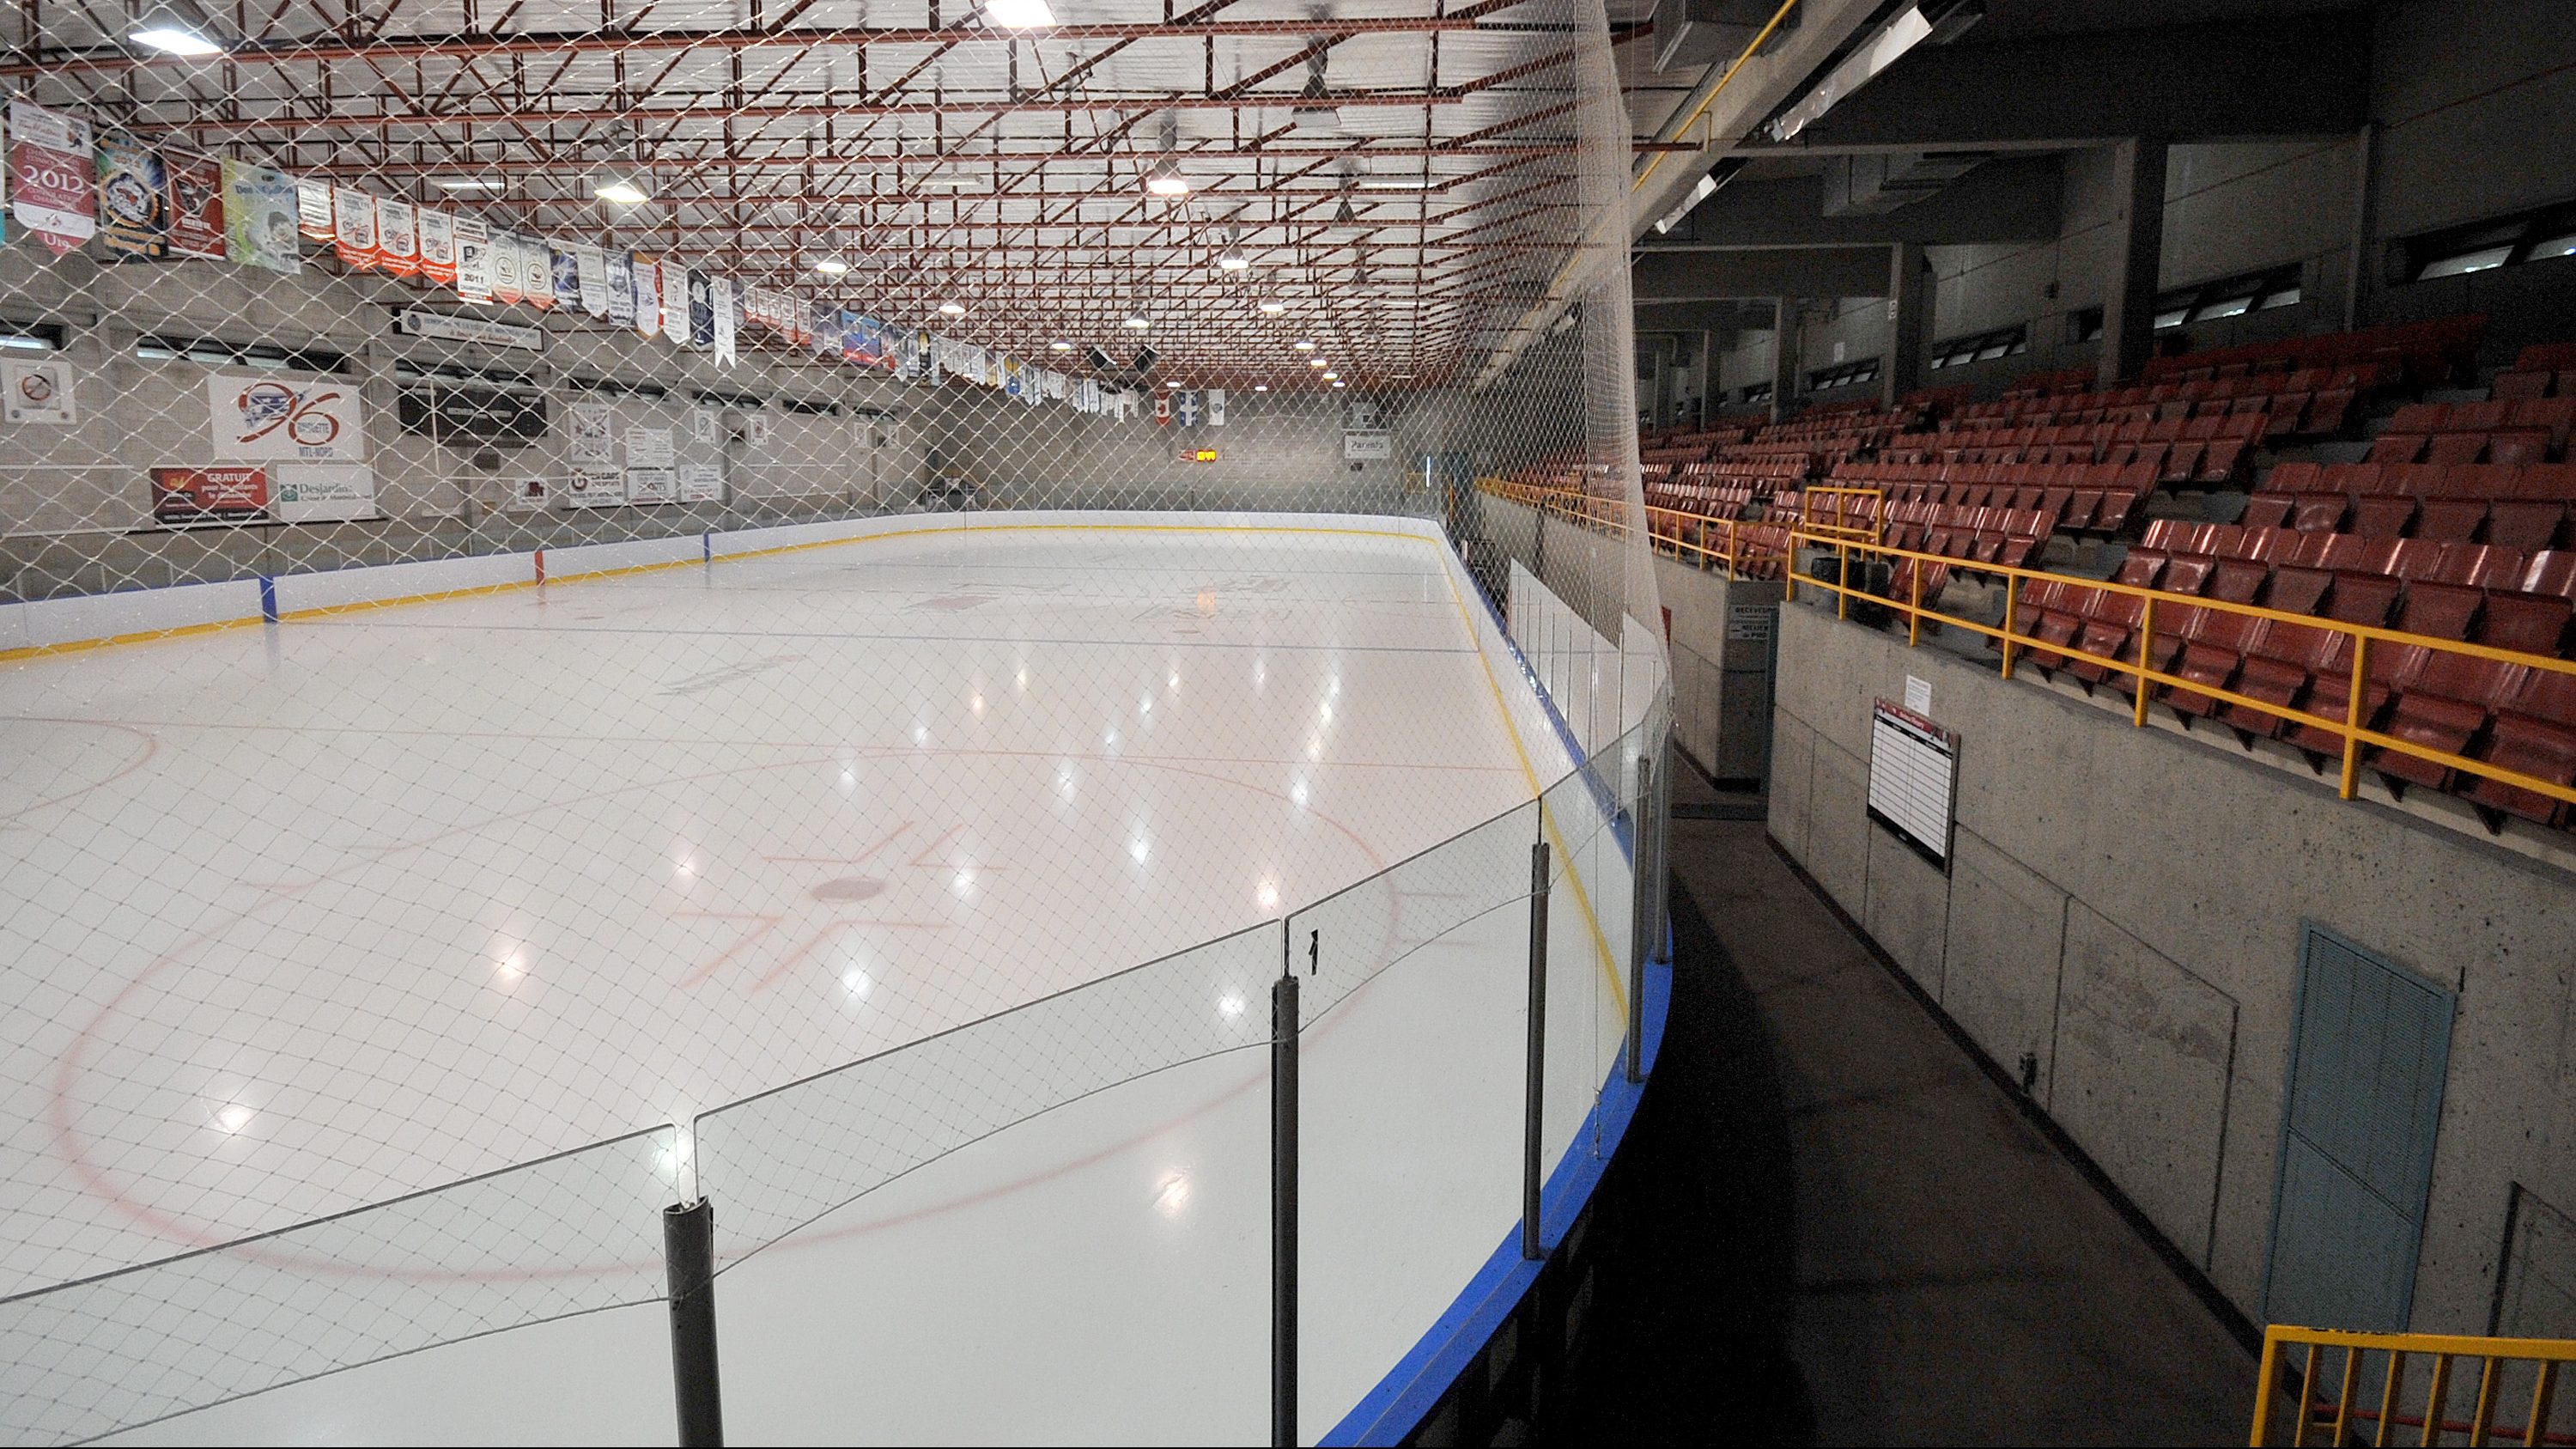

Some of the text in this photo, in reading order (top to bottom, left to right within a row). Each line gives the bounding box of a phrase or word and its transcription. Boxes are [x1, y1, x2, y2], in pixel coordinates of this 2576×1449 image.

[22, 164, 86, 194] 2012
[44, 232, 71, 252] U19
[464, 273, 484, 284] 2011
